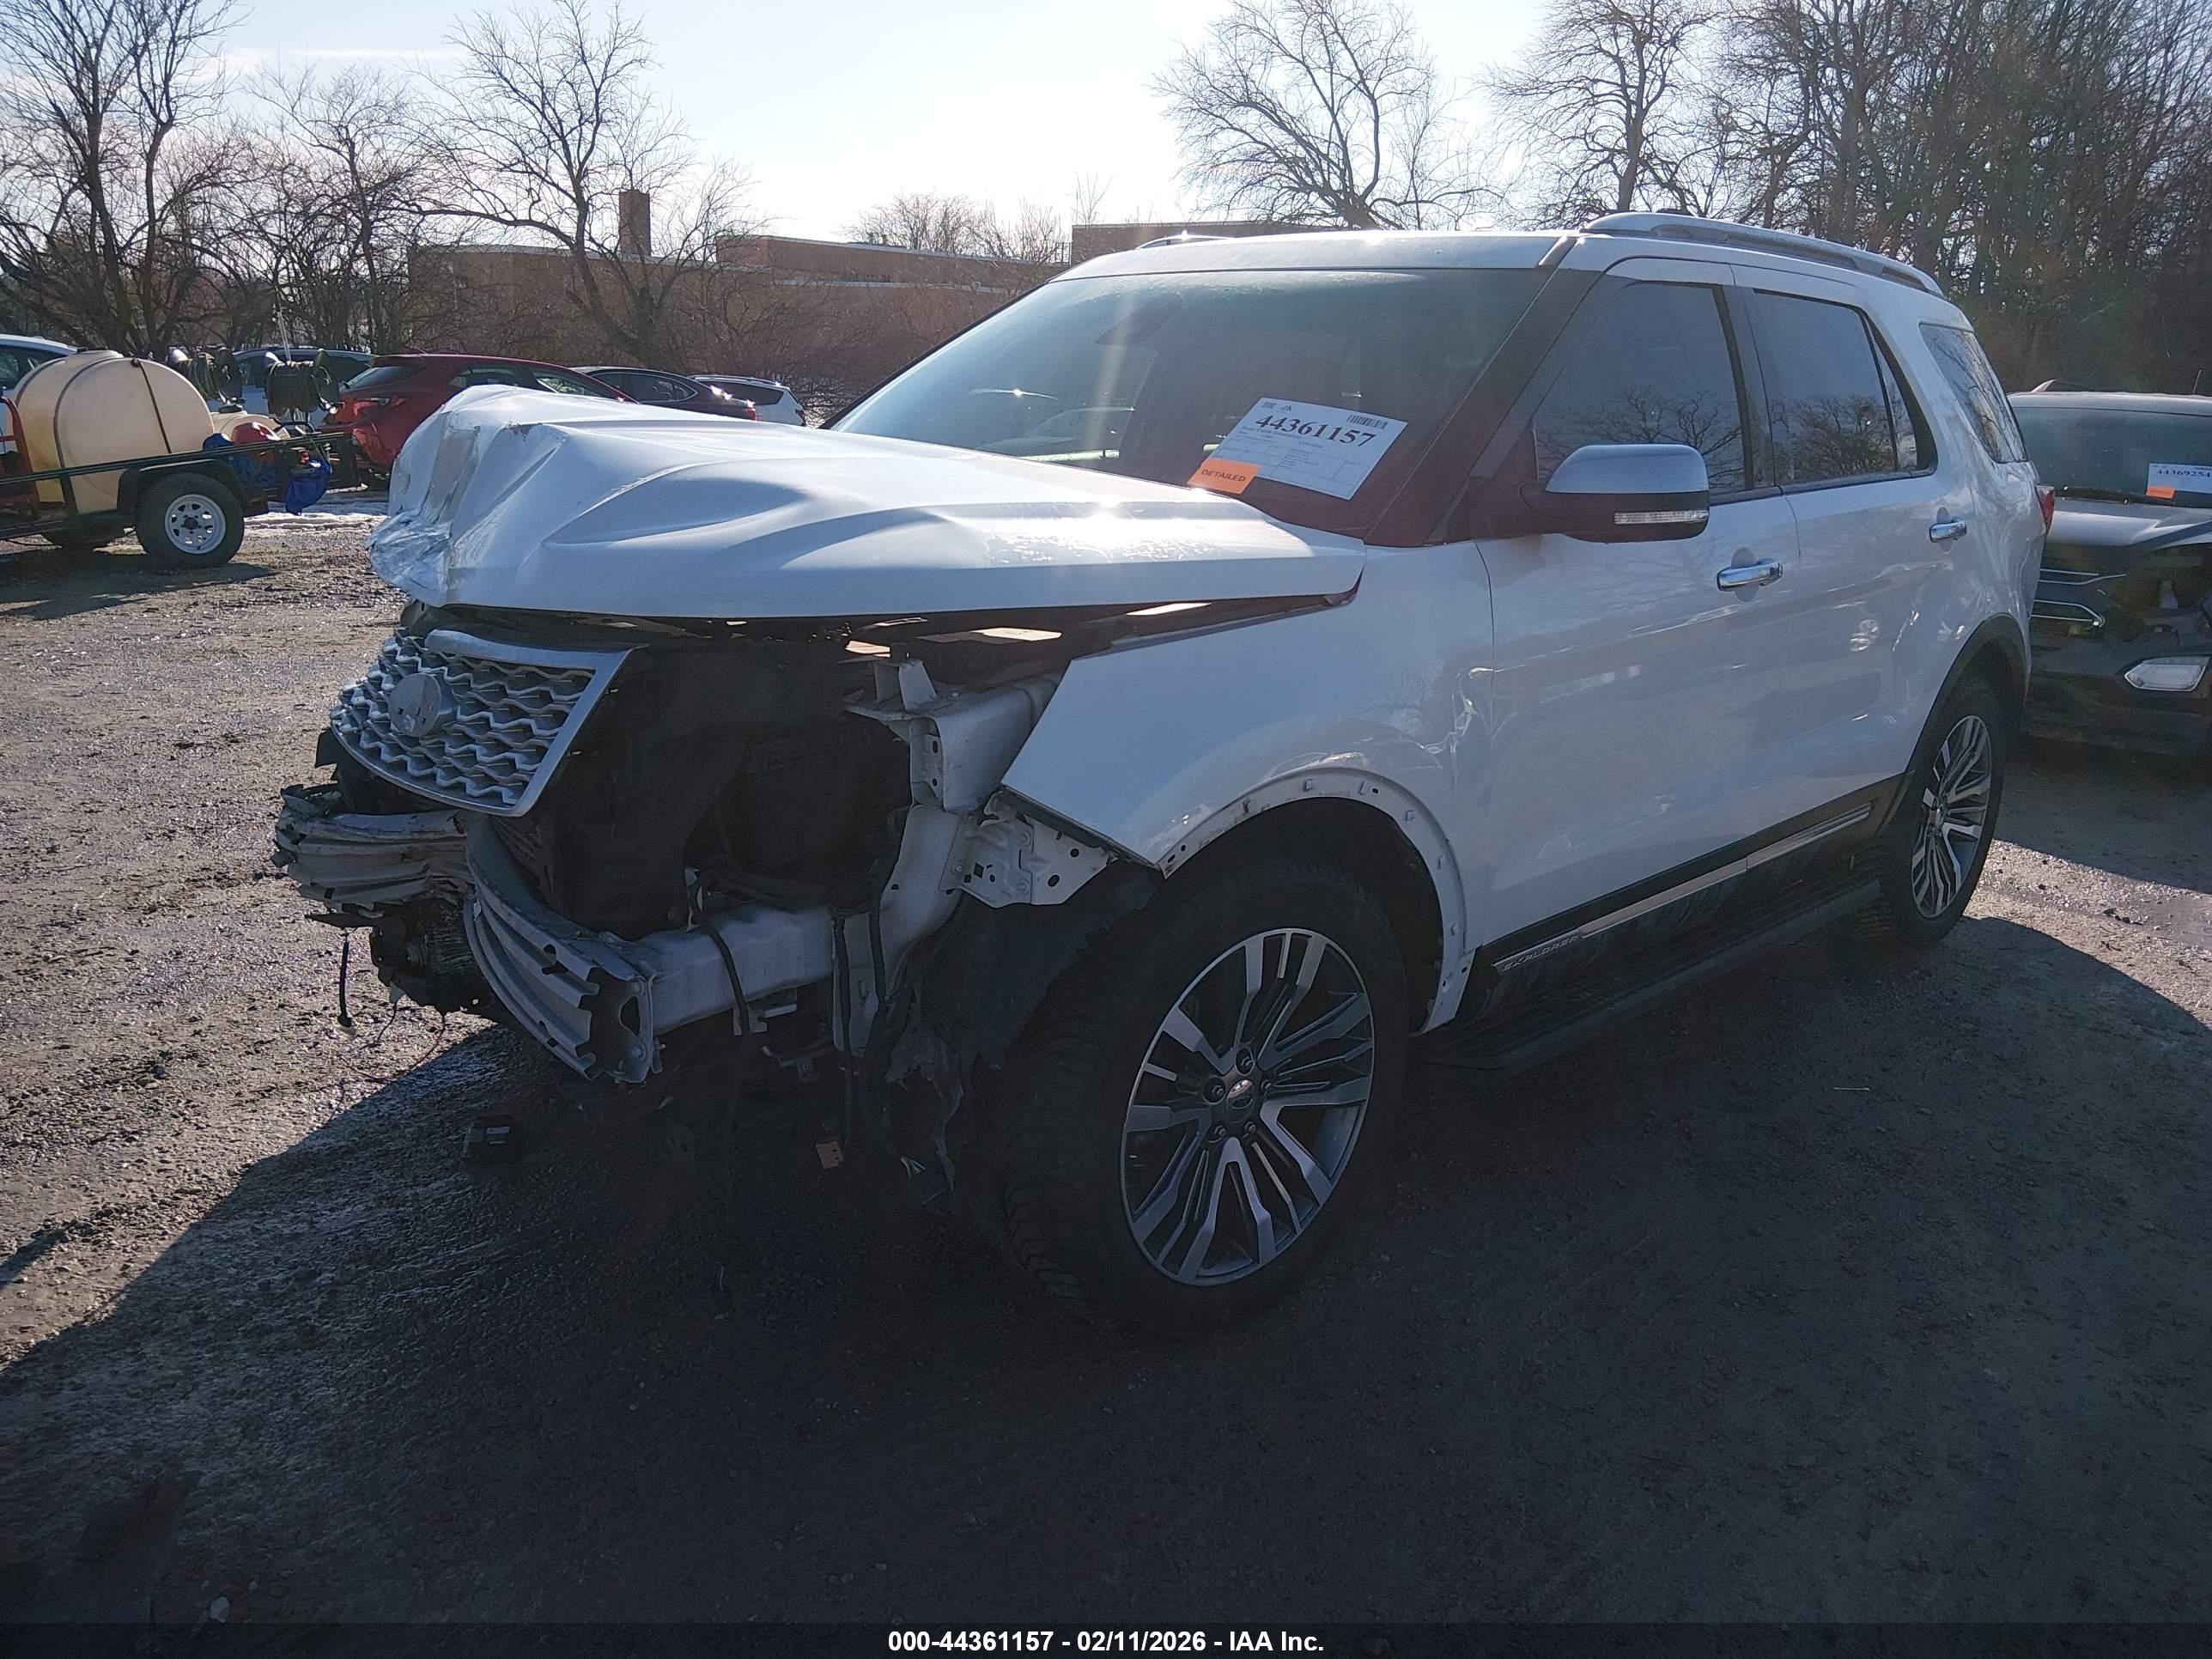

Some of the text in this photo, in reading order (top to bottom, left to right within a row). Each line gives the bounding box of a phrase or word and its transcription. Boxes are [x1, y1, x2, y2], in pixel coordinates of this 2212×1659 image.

[1255, 415, 1376, 447] 44361157
[1200, 469, 1246, 482] DETAILED
[1502, 935, 1578, 972] EXPLORER
